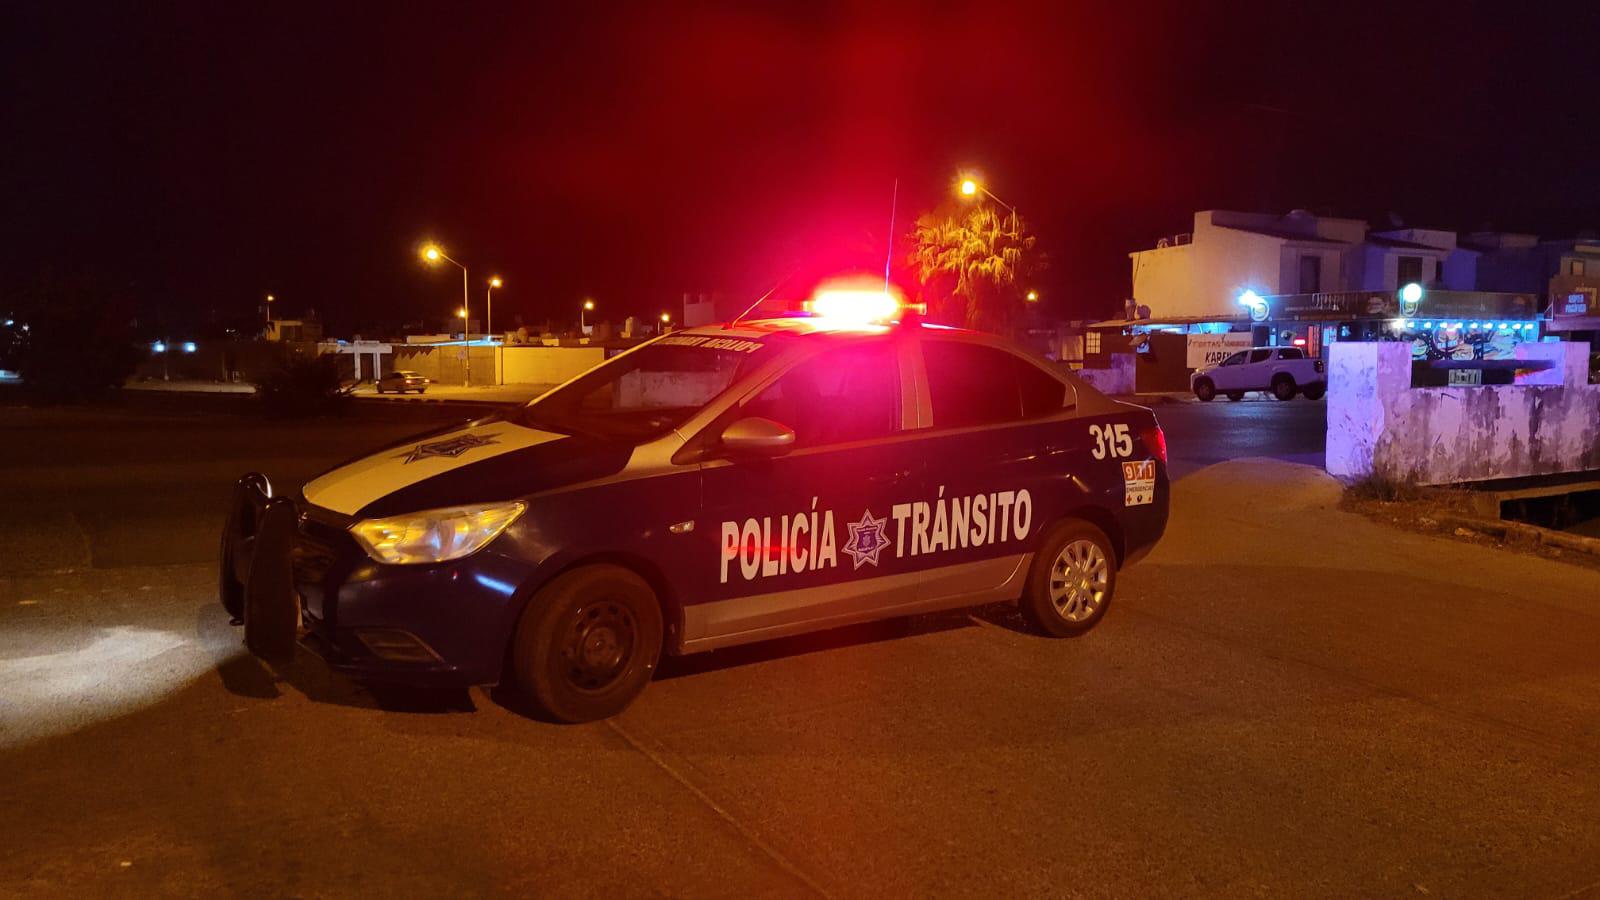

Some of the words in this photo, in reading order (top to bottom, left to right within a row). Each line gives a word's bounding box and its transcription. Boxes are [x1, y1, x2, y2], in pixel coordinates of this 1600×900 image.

[1089, 423, 1133, 460] 315
[1125, 463, 1153, 480] 911
[720, 496, 837, 584] POLICÍA
[892, 486, 1032, 559] TRÁNSITO
